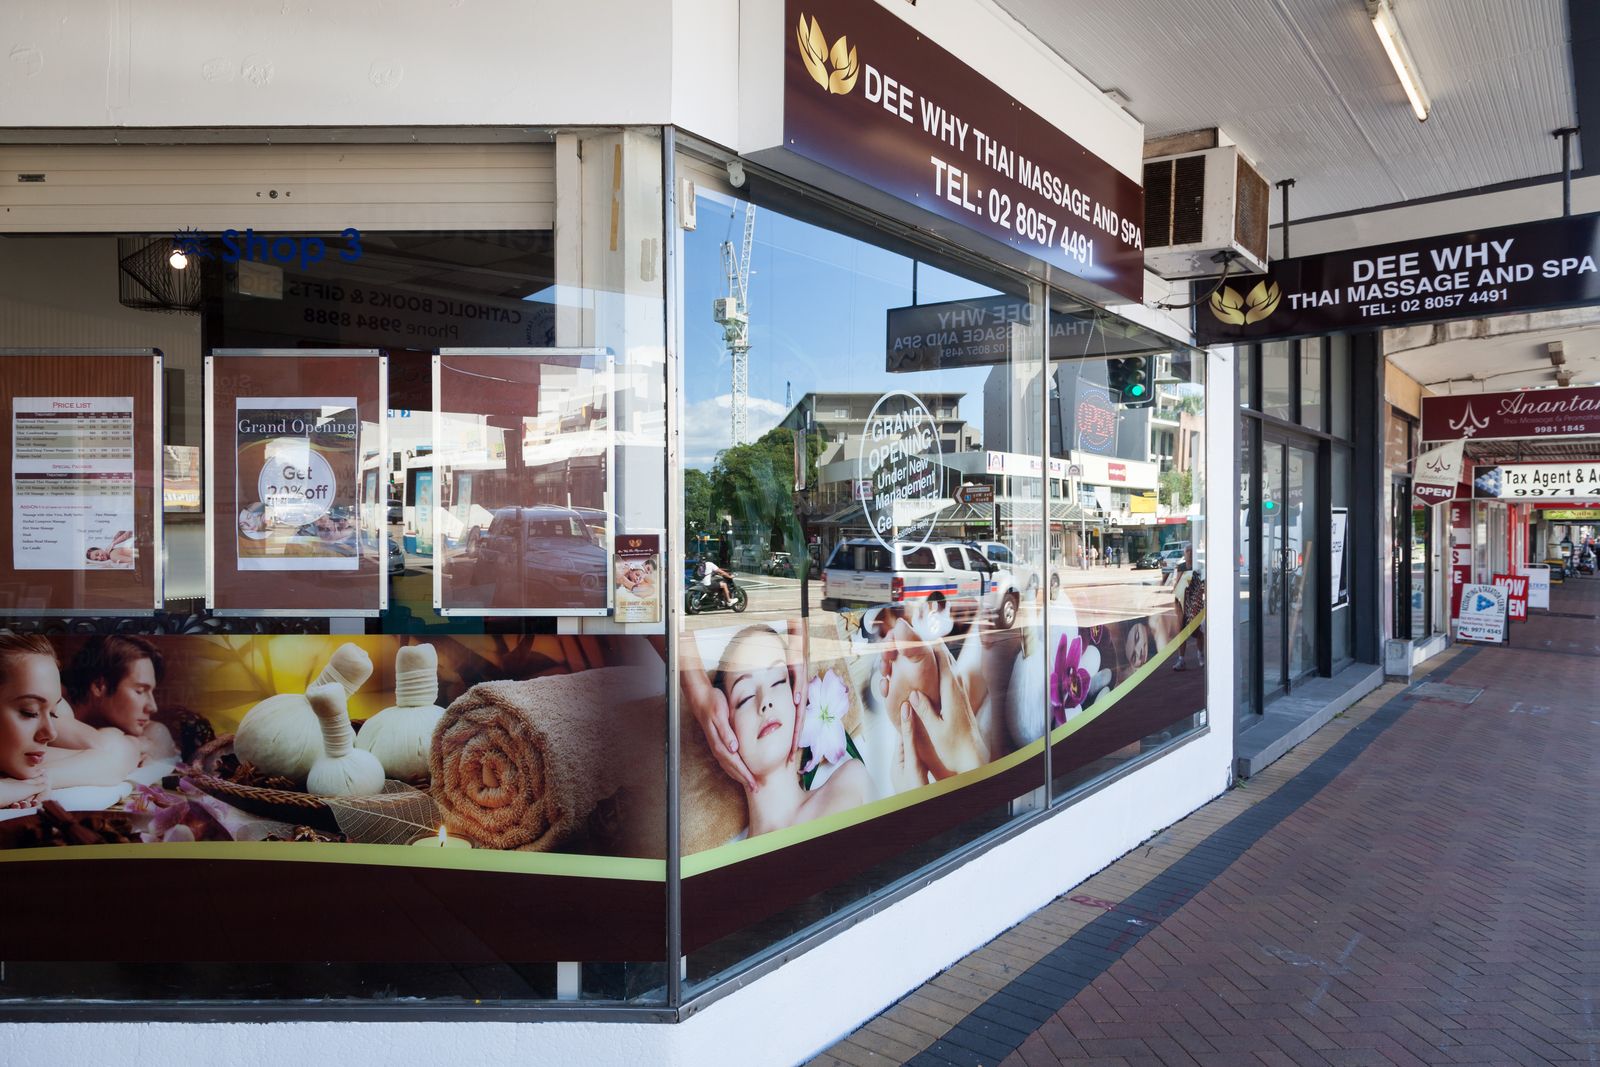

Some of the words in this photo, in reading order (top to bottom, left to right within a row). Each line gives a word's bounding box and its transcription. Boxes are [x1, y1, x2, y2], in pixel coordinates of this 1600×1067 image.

[865, 63, 914, 124] DEE
[920, 96, 969, 152] WHY
[973, 128, 1014, 179] THAI
[1018, 156, 1090, 221] MASSAGE
[1093, 203, 1118, 235] AND
[1122, 218, 1142, 251] SPA
[930, 156, 983, 216] TEL:
[989, 188, 1011, 229] 02
[1016, 203, 1057, 247] 8057
[1061, 226, 1094, 267] 4491
[220, 228, 326, 271] Shop
[340, 228, 362, 262] 3
[1352, 252, 1420, 283] DEE
[1430, 238, 1514, 271] WHY
[1288, 289, 1340, 309] THAI
[1347, 271, 1470, 303] MASSAGE
[1477, 264, 1534, 287] AND
[1542, 255, 1598, 279] SPA
[1360, 302, 1396, 317] TEL:
[1401, 300, 1420, 312] 02
[1424, 294, 1463, 310] 8057
[1468, 288, 1508, 304] 4491
[239, 420, 286, 433] Grand
[292, 420, 356, 438] Opening
[872, 407, 922, 442] GRAND
[869, 429, 932, 471] OPENING
[283, 466, 312, 480] Get
[878, 466, 906, 489] Under
[910, 458, 928, 476] New
[1505, 470, 1527, 484] Tax
[1534, 467, 1571, 488] Agent
[1576, 468, 1584, 482] &
[1589, 469, 1600, 483] A
[876, 472, 935, 510] Management
[1416, 486, 1452, 498] OPEN
[1495, 578, 1525, 596] NOW
